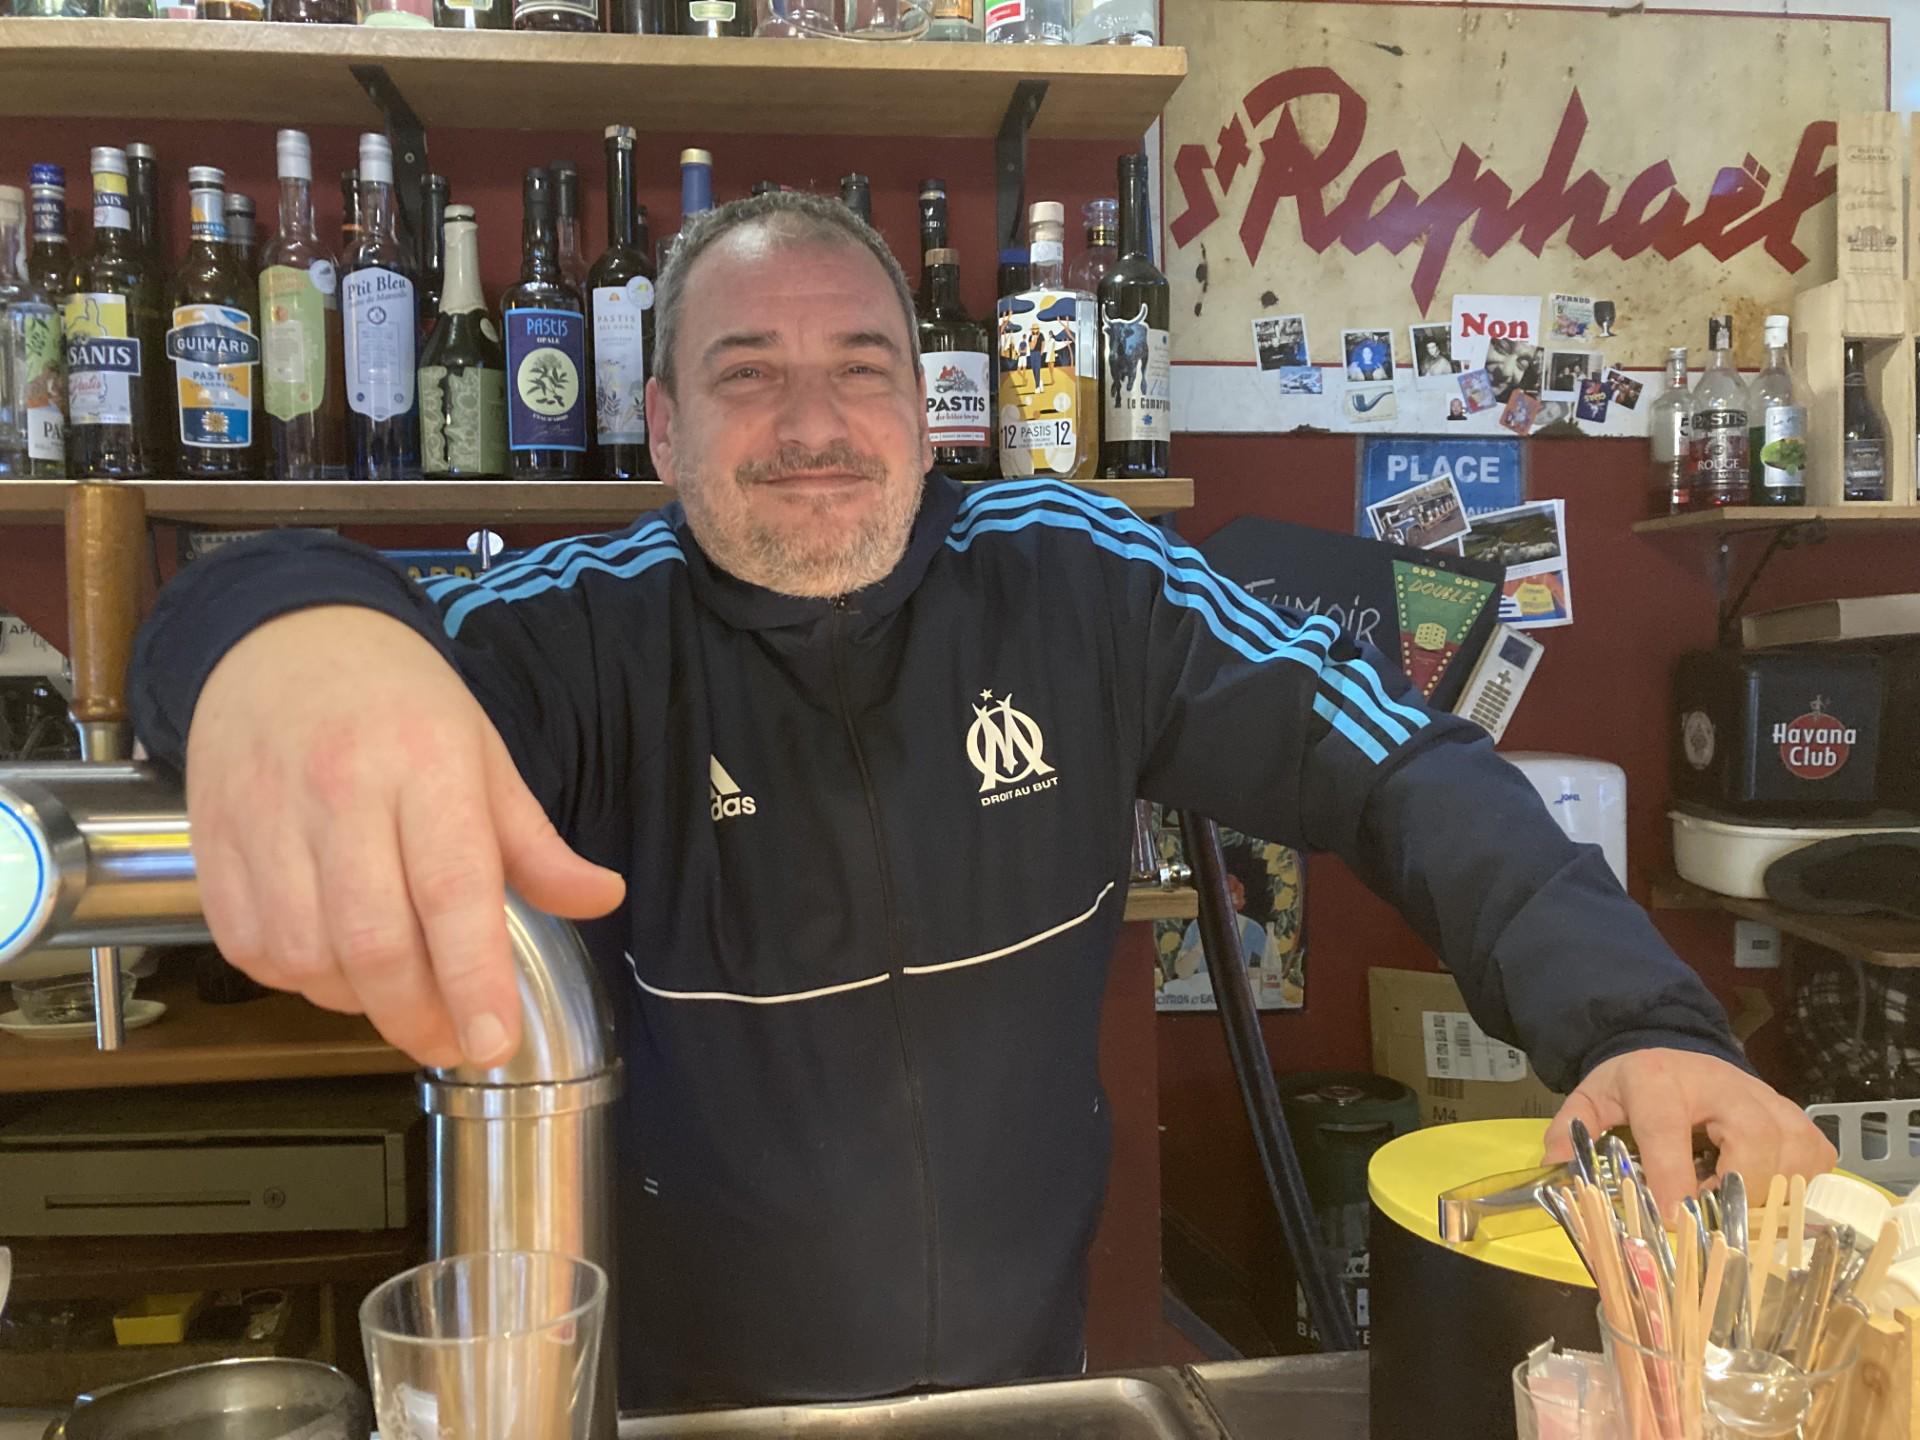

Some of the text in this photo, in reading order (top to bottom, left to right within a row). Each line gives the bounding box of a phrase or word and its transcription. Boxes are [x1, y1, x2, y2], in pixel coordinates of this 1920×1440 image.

[1461, 313, 1529, 339] Non
[177, 337, 249, 354] GUIMARD
[192, 370, 234, 381] PASTIS
[926, 396, 985, 412] PASTIS
[1693, 412, 1745, 428] PSTIS
[1055, 421, 1071, 446] 12
[1387, 455, 1500, 483] PLACE
[1697, 458, 1741, 471] ROUGE
[1772, 723, 1857, 745] Havana
[1789, 746, 1838, 766] Club
[1033, 777, 1059, 793] BUT
[1200, 993, 1217, 1004] EA
